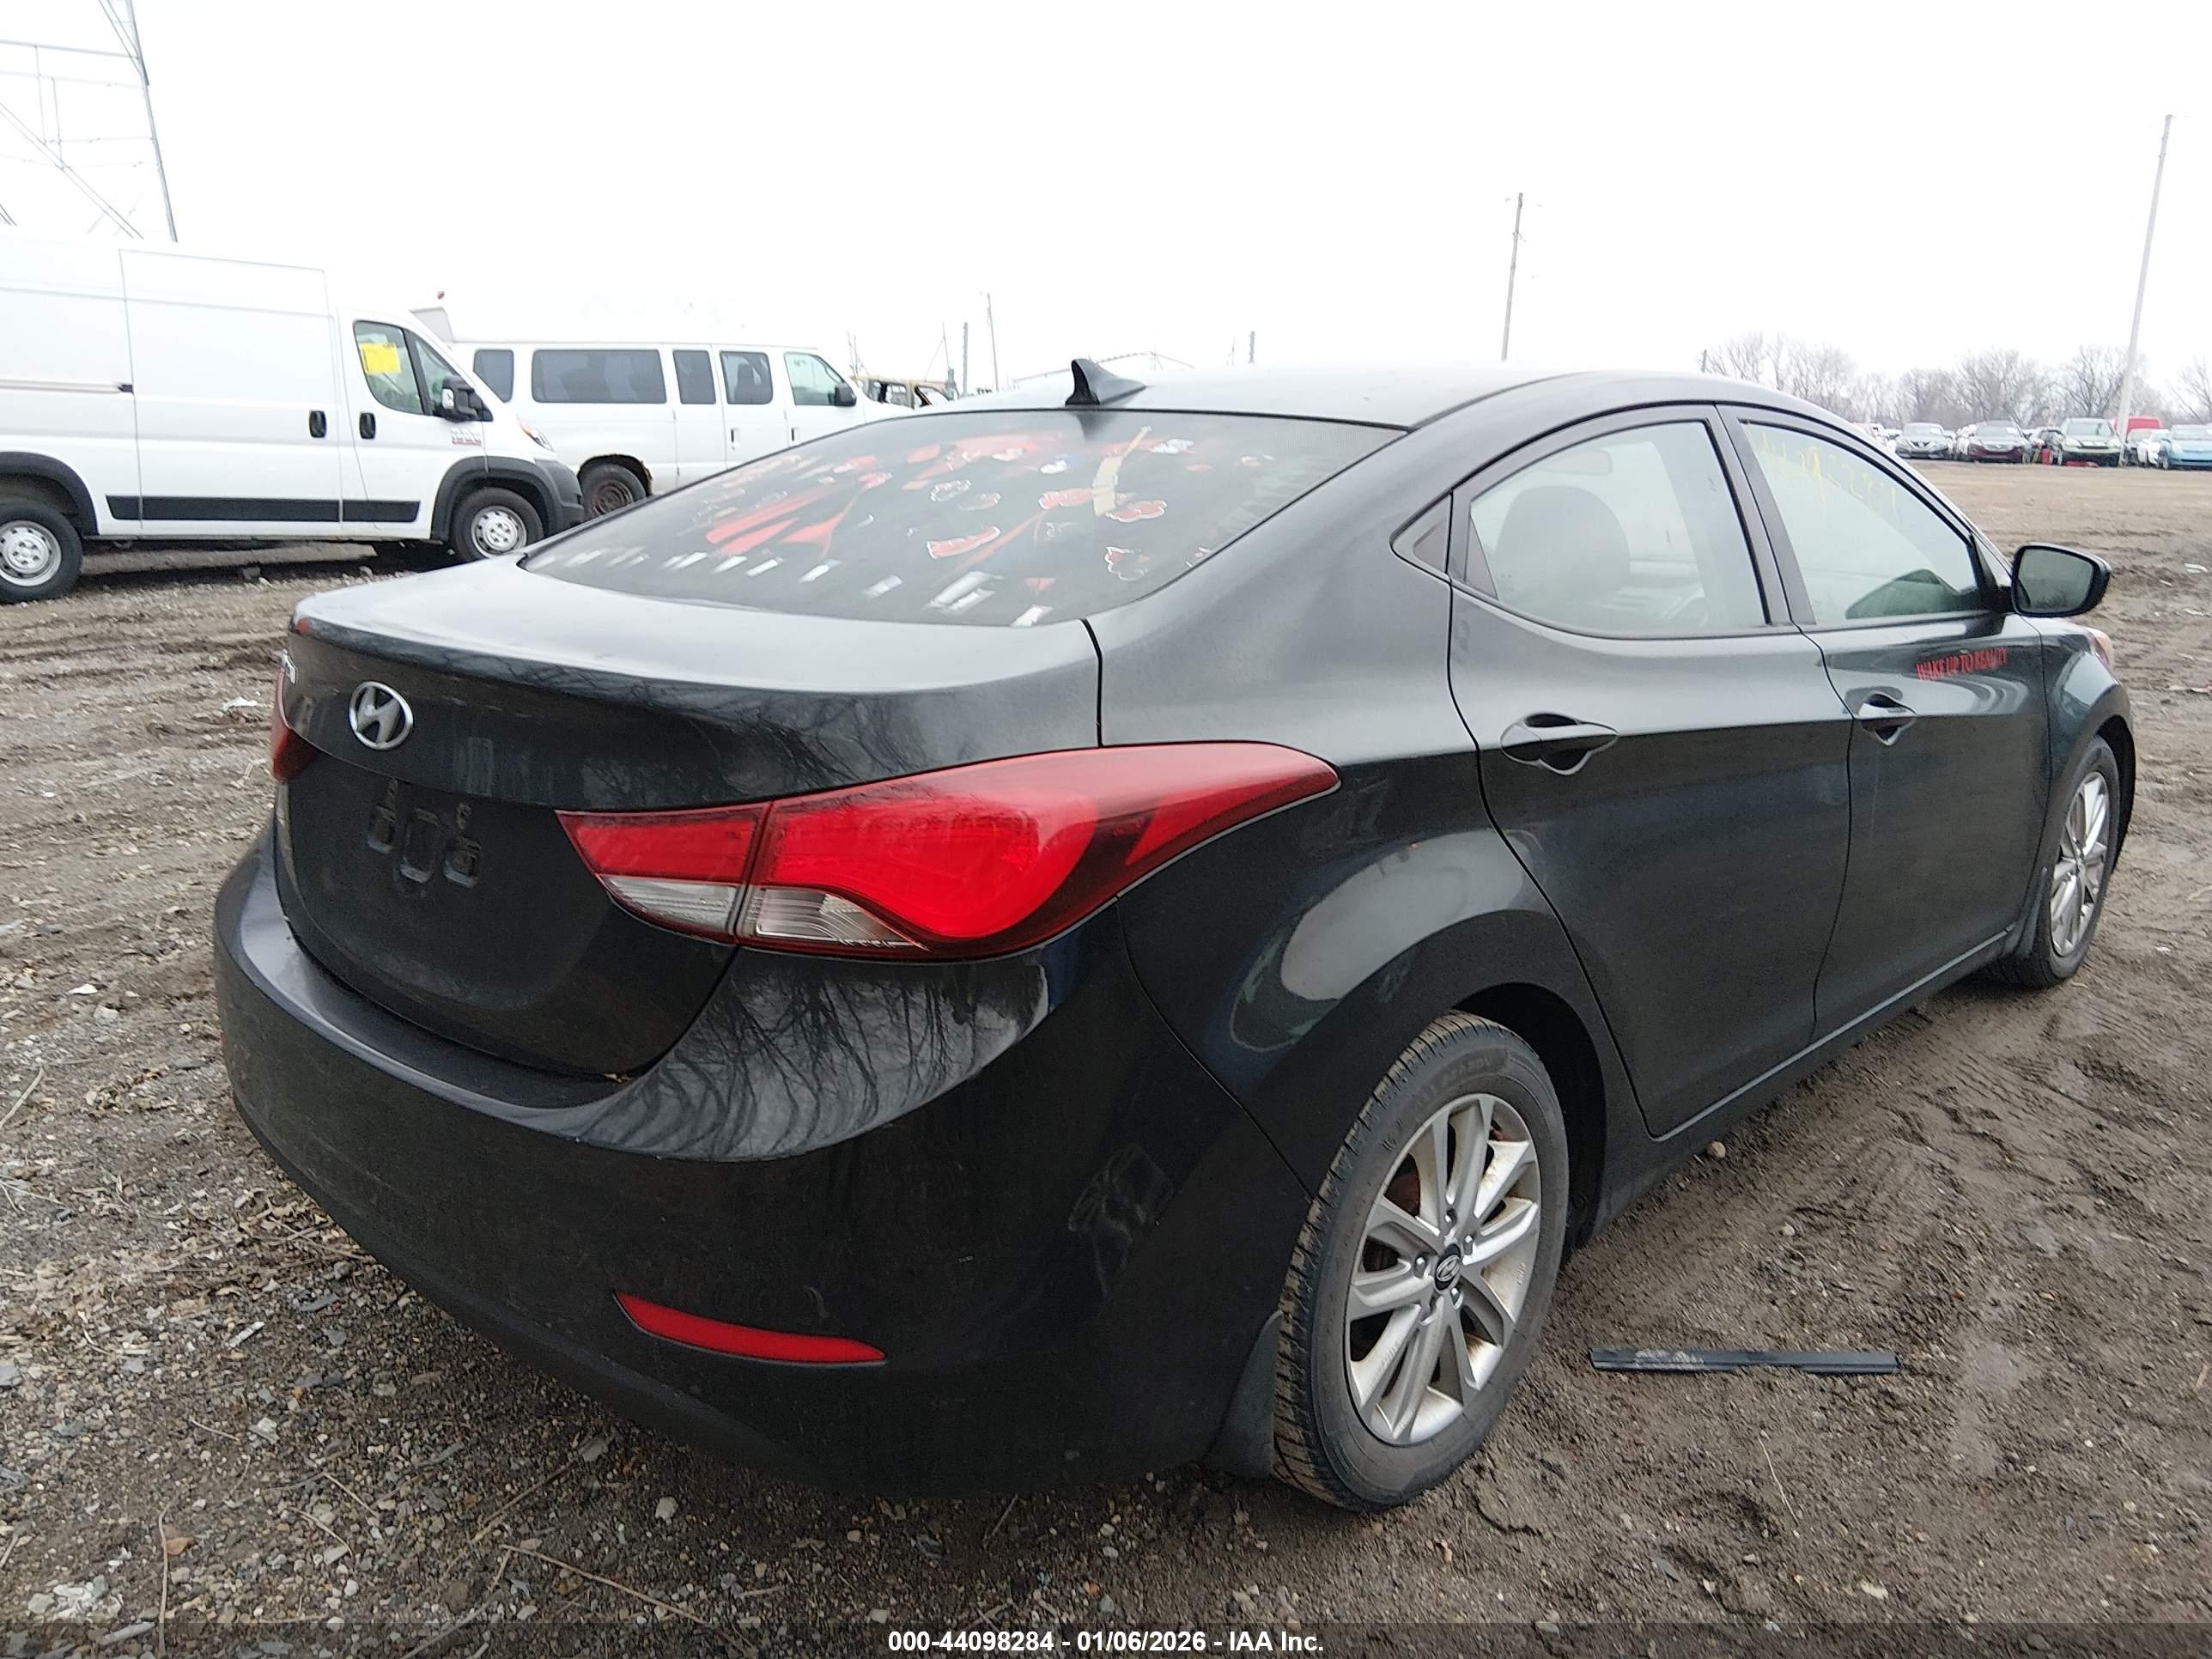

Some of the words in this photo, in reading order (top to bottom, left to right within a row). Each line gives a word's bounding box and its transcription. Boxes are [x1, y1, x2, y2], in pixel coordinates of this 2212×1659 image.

[1917, 659, 1945, 680] WAKE
[1946, 655, 1959, 676] UP
[1959, 653, 1973, 674] TO
[1974, 647, 2008, 670] REALITY
